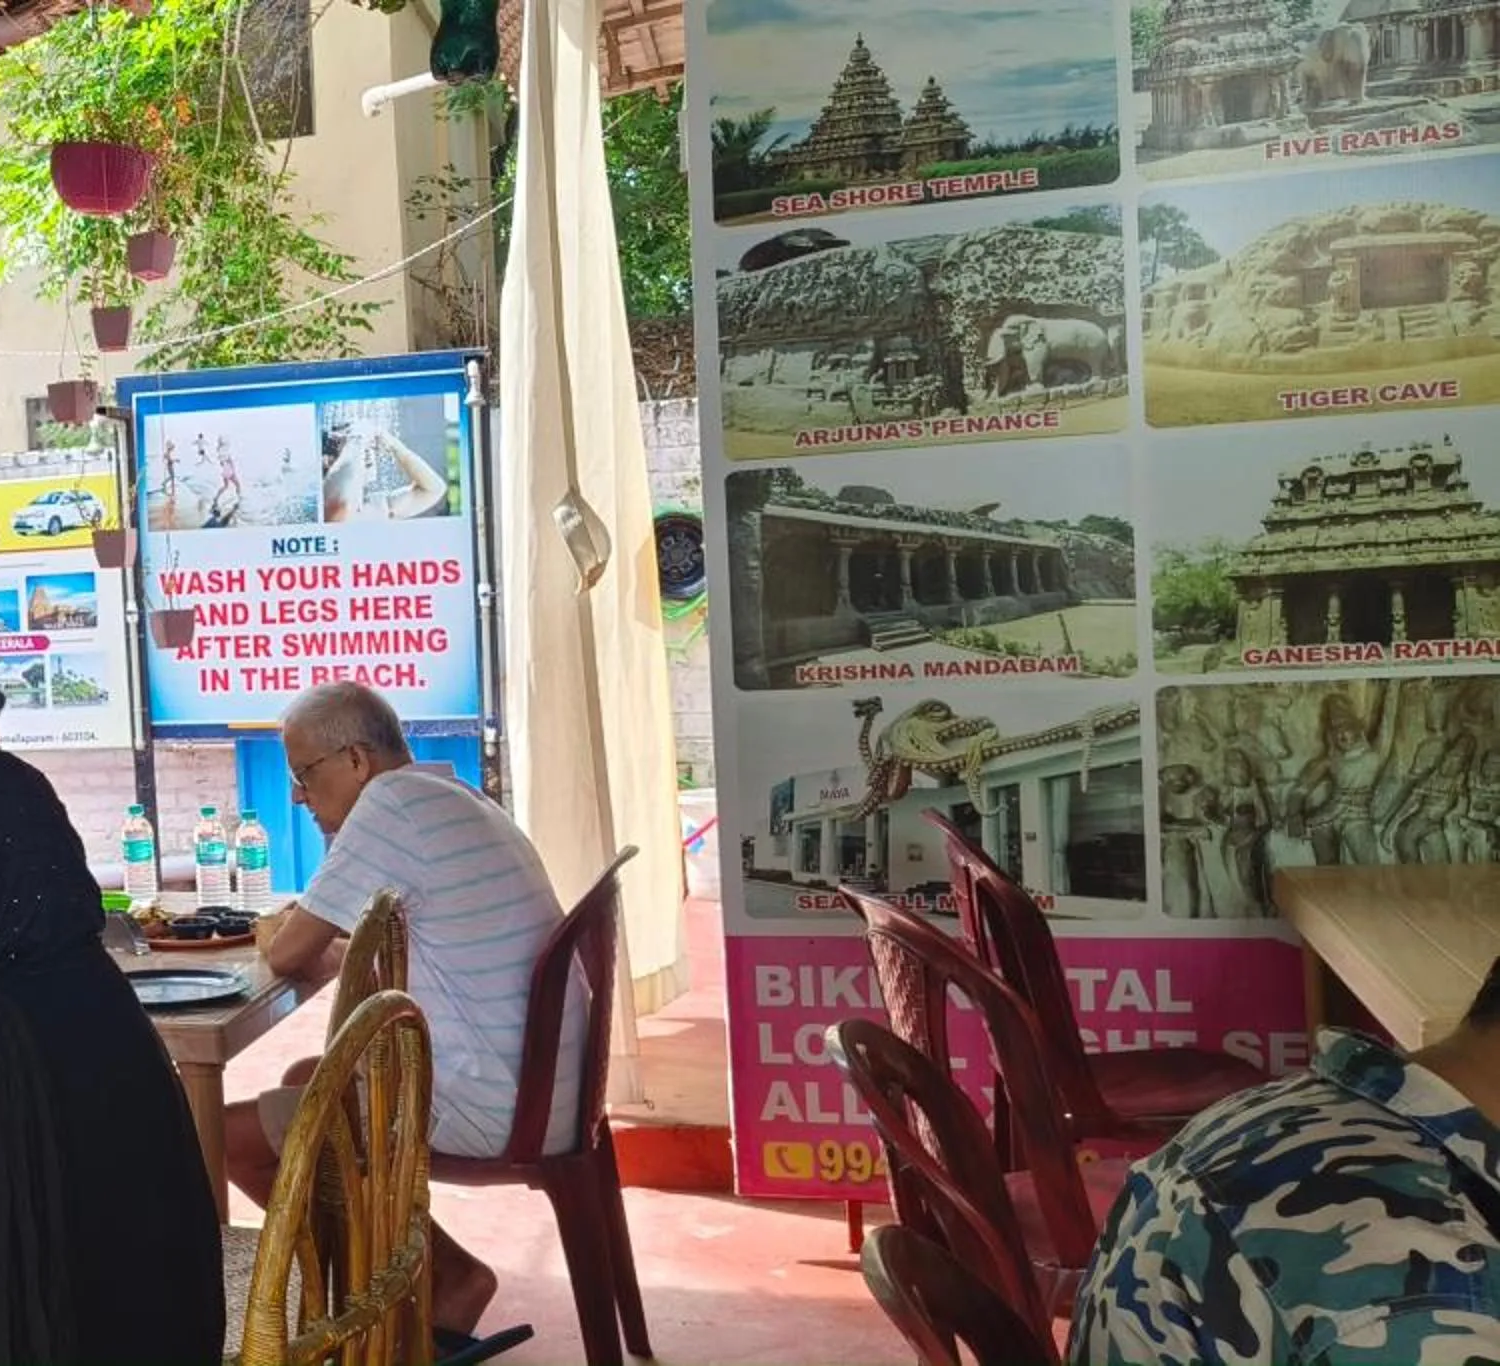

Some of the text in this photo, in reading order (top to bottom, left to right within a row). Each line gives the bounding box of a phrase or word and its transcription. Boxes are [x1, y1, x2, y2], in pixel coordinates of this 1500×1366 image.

[1265, 121, 1462, 159] FIVE RATHAS
[771, 168, 1038, 216] SEA SHORE TEMPLE
[1279, 380, 1459, 410] TIGER CAVE
[794, 410, 1060, 448] ARJUNA'S PENANCE
[271, 535, 327, 555] NOTE
[160, 560, 461, 595] WASH YOUR HANDS
[194, 595, 433, 626] AND LEGS HERE
[177, 629, 448, 660] AFTER SWIMMING
[1242, 638, 1500, 667] GANESHA RATHA
[201, 669, 228, 692] IN
[240, 667, 300, 690] THE
[797, 655, 1081, 682] KRISHNA MANDABAM
[797, 894, 847, 910] SEA
[755, 965, 884, 1008] BIK
